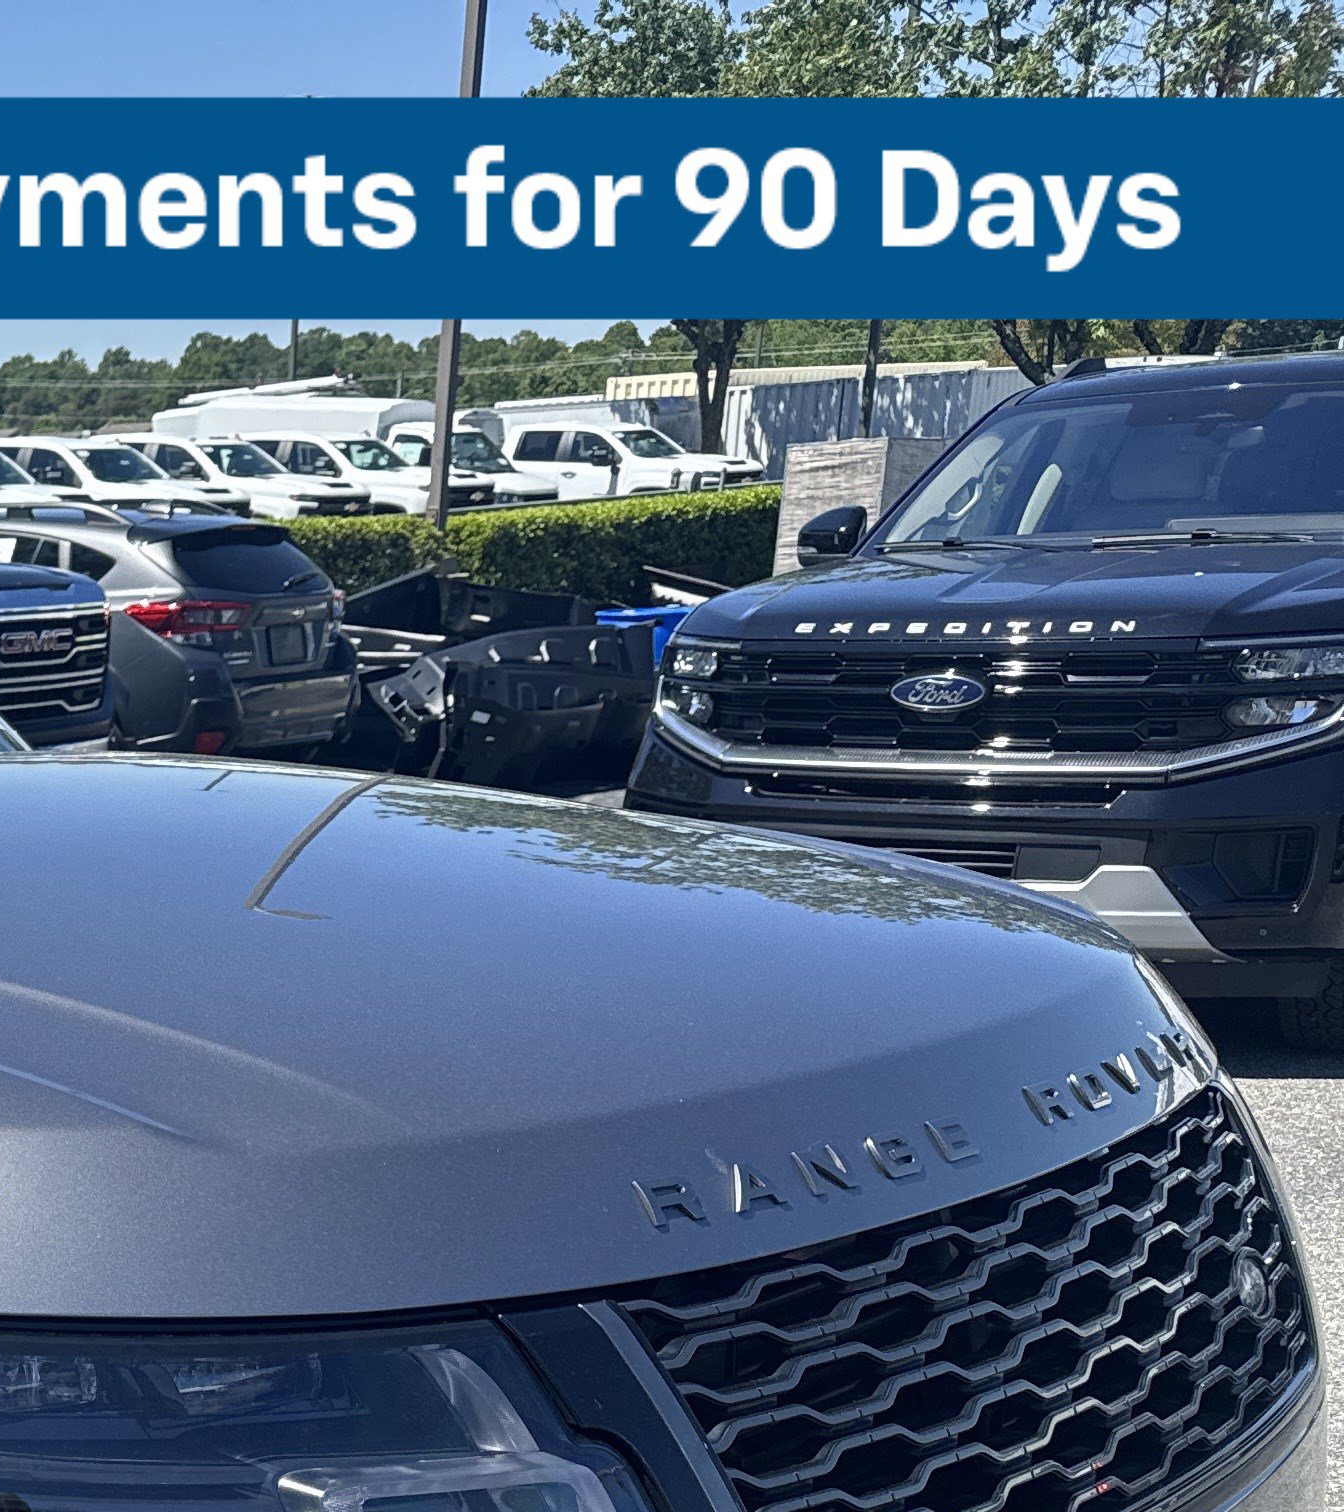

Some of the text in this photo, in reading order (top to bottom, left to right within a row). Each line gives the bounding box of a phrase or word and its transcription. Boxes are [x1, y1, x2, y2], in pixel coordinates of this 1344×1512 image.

[794, 619, 1137, 635] EXPEDITION
[0, 627, 74, 655] GMC
[906, 678, 969, 705] Ford
[630, 1025, 1209, 1228] RANGE ROVER
